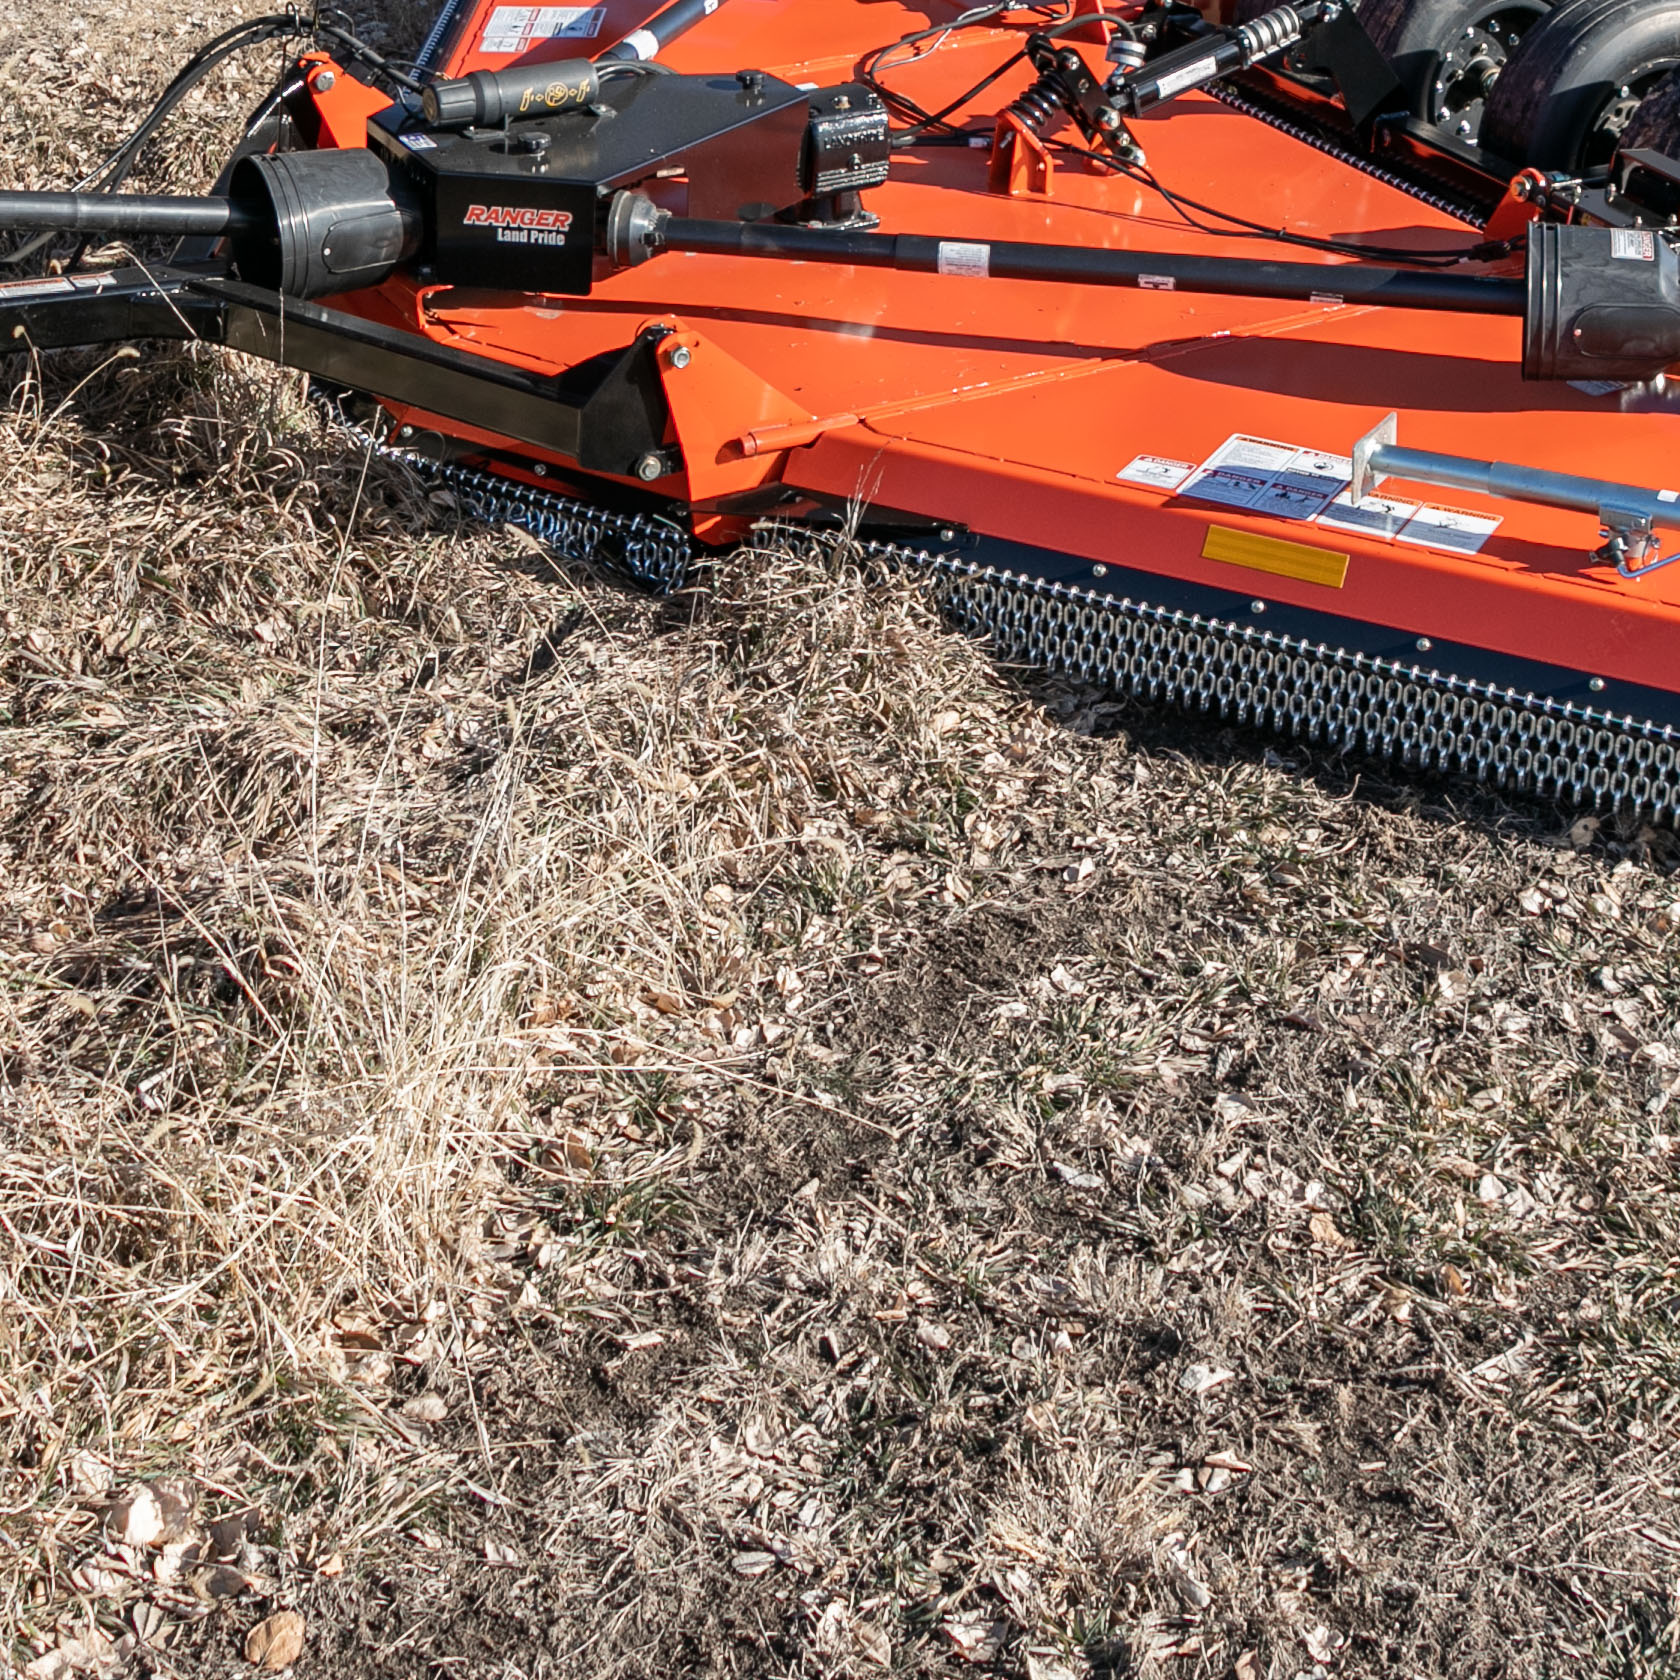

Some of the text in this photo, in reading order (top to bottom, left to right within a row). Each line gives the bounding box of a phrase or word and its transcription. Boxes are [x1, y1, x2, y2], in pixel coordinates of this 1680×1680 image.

[464, 205, 573, 231] RANGER
[497, 228, 565, 246] Land Pride
